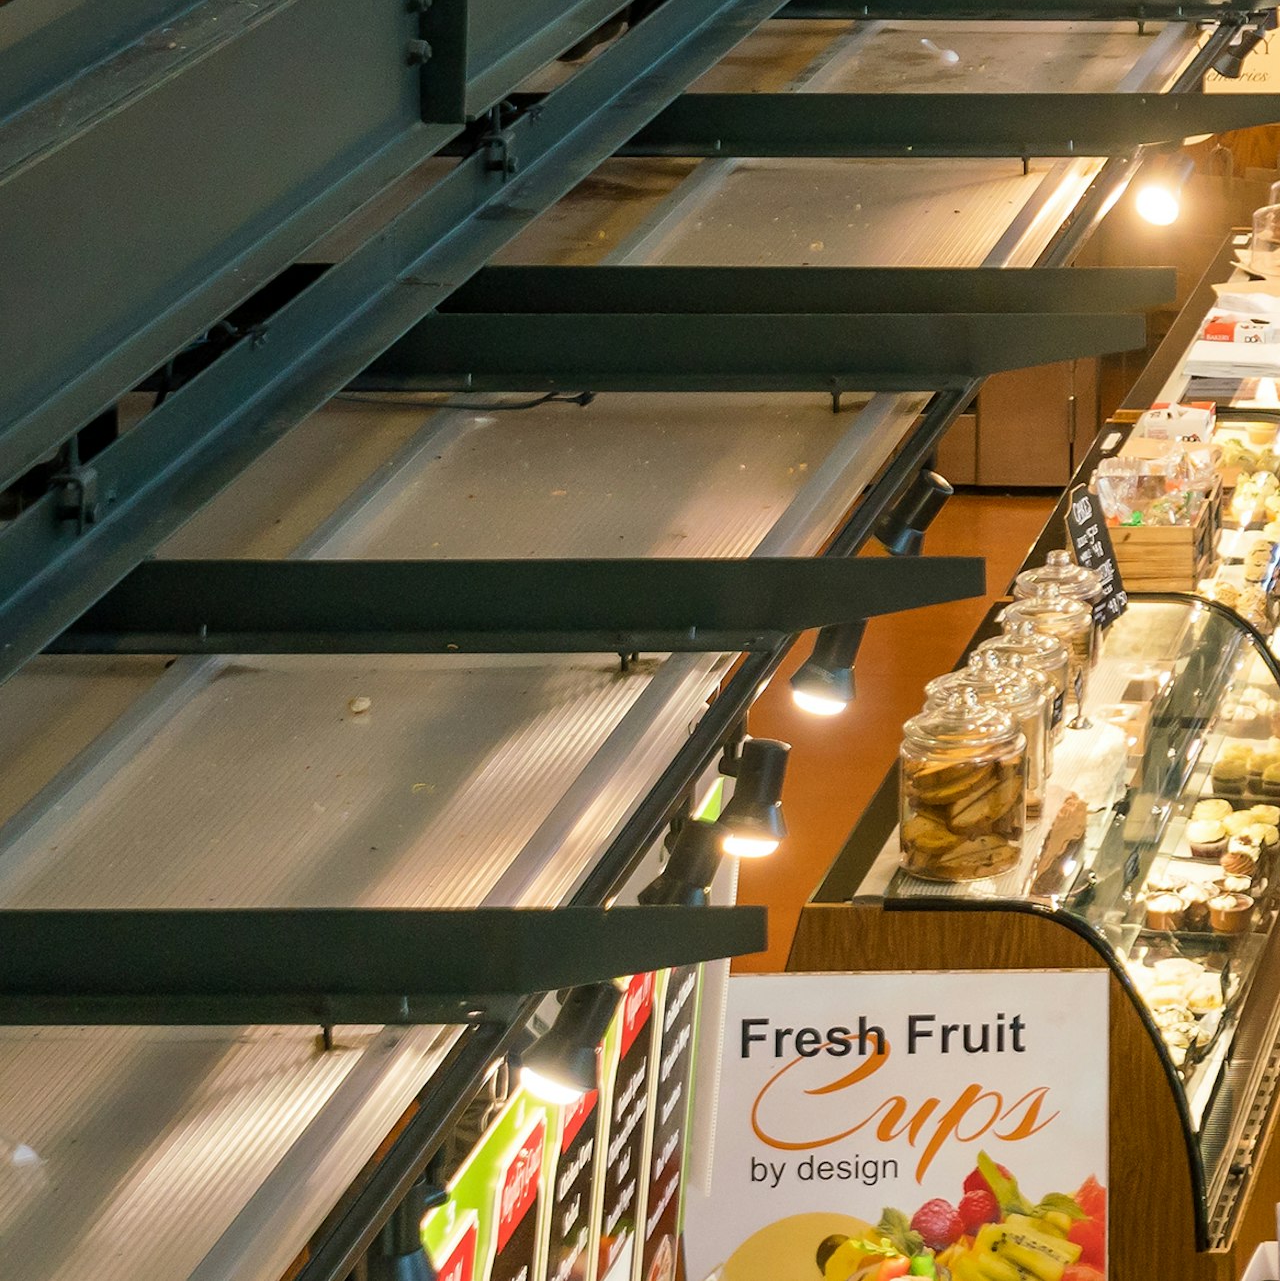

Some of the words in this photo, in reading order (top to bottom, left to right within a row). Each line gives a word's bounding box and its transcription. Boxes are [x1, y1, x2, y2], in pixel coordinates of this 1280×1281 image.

[741, 1015, 886, 1059] Fresh
[906, 1012, 1027, 1055] Fruit
[752, 1032, 1060, 1186] Cups
[751, 1155, 787, 1188] by
[797, 1154, 899, 1186] design
